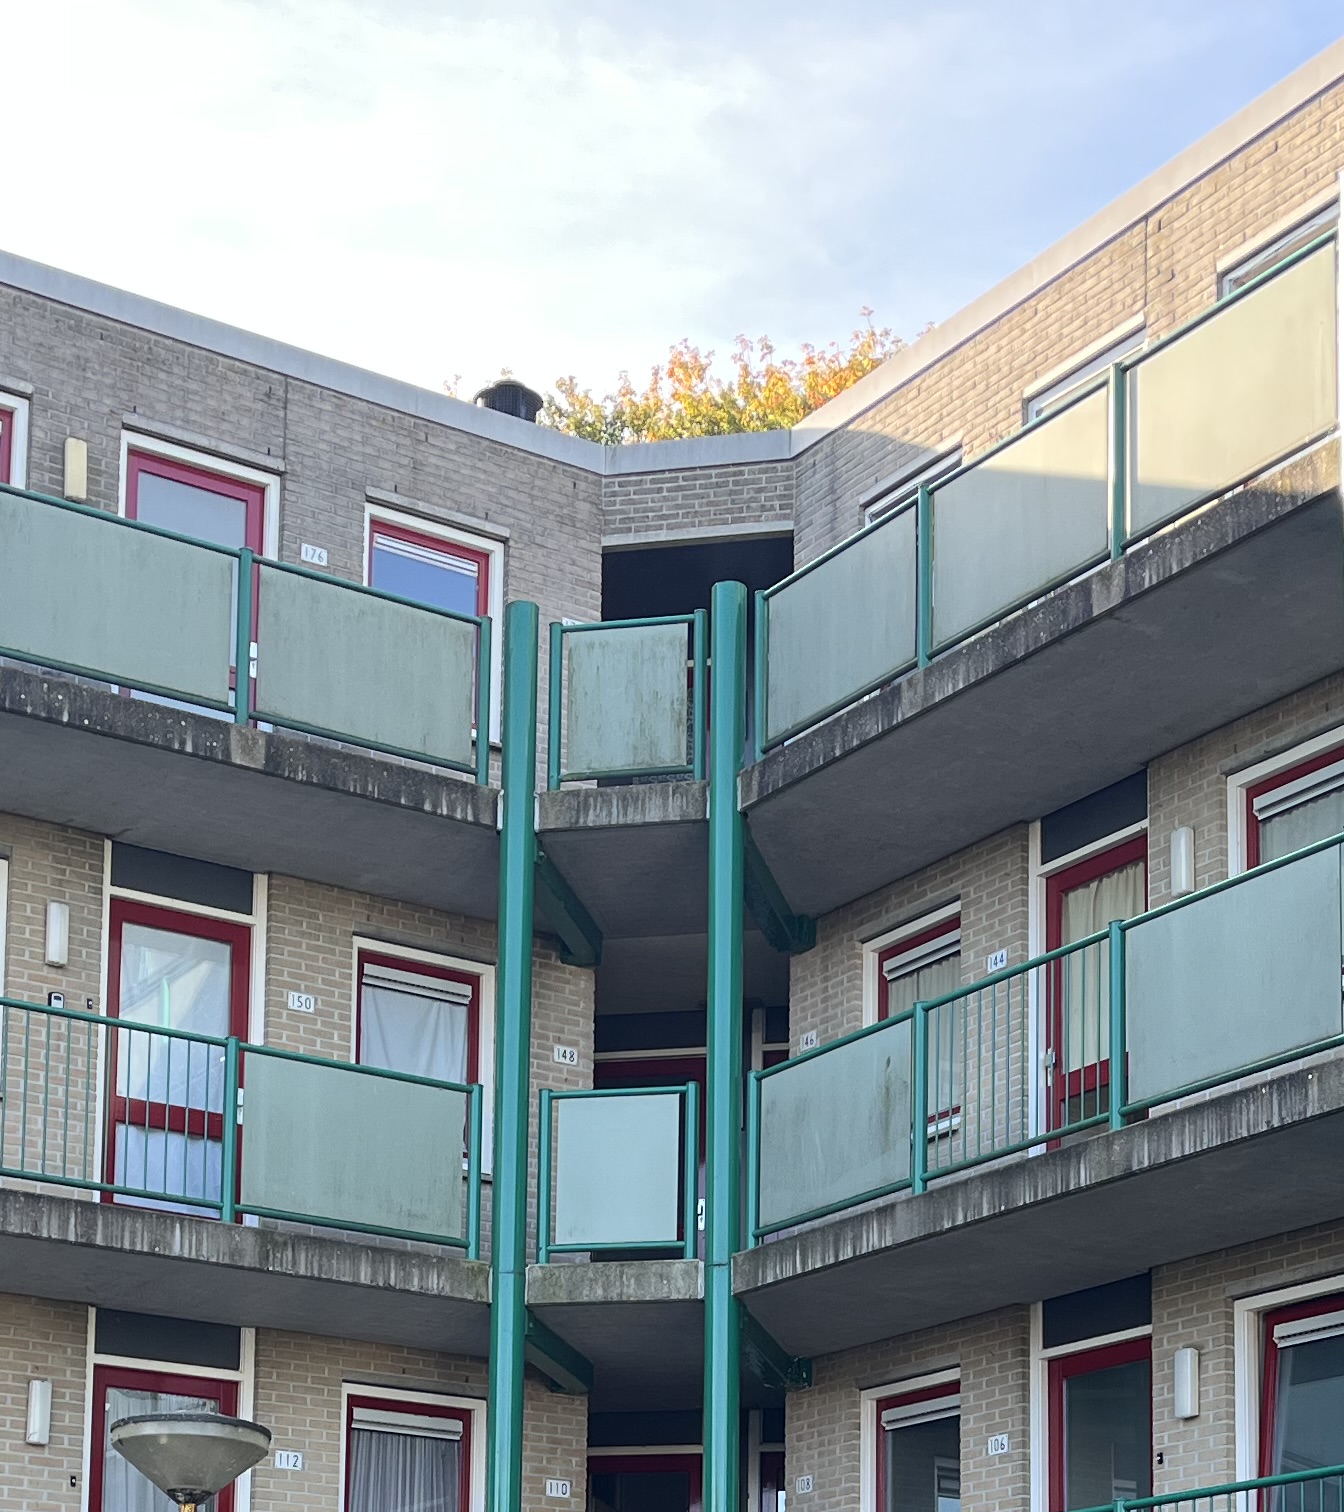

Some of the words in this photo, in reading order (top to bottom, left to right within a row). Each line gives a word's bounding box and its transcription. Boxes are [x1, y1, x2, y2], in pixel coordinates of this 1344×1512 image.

[304, 543, 325, 564] 176
[989, 953, 1005, 970] 144
[291, 995, 312, 1010] 150
[801, 1033, 815, 1050] 146
[556, 1047, 575, 1063] 148
[989, 1437, 1006, 1453] 106
[279, 1451, 299, 1468] 112
[549, 1481, 568, 1496] 110
[797, 1476, 811, 1491] 108
